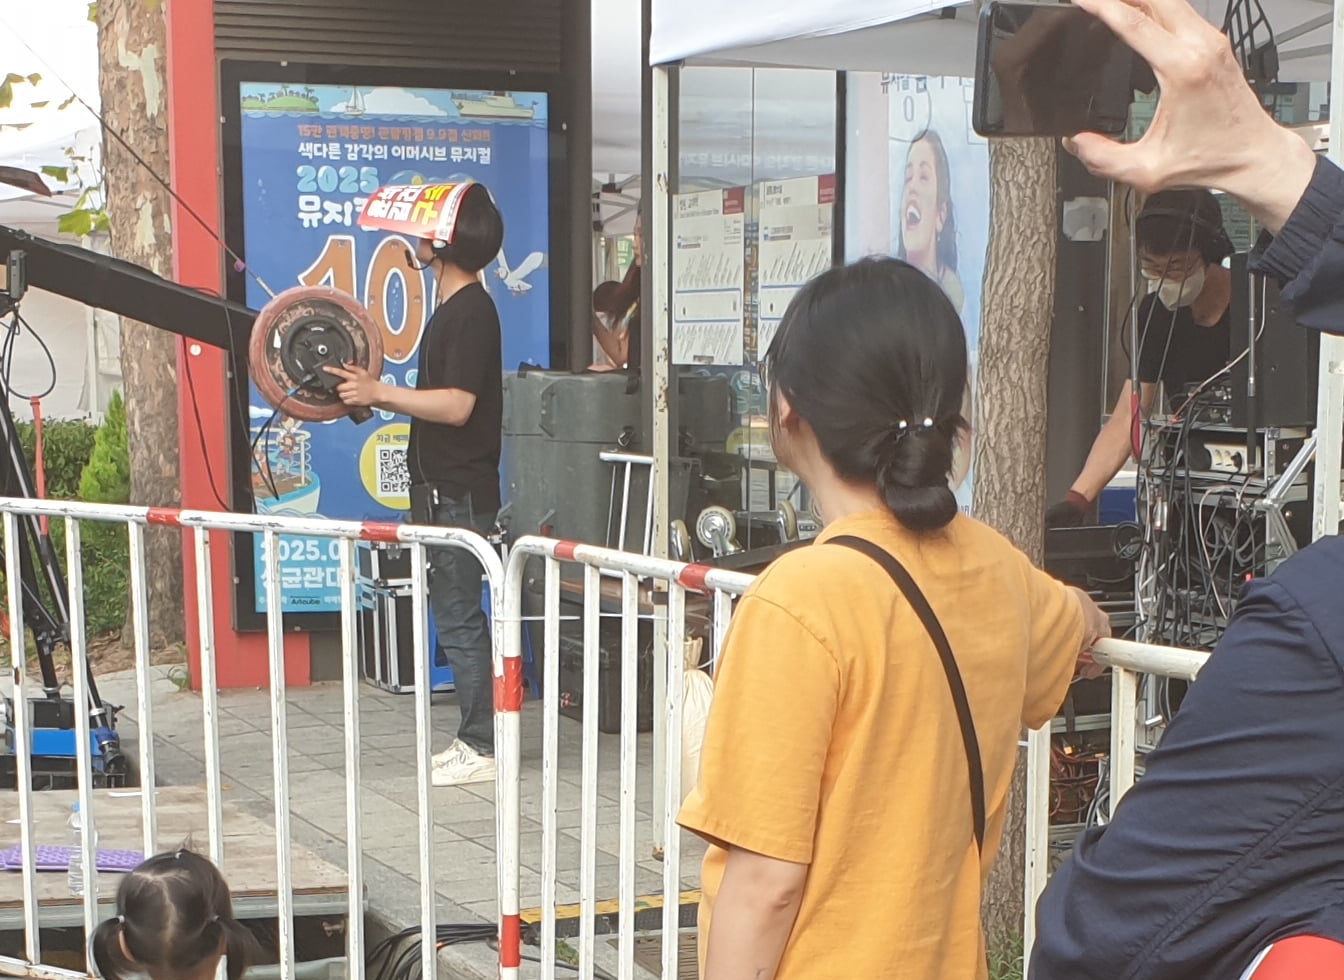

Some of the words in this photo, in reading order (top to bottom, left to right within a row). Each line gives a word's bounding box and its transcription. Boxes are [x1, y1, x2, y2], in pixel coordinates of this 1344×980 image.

[298, 142, 341, 160] 색다른
[344, 143, 388, 161] 감각의
[391, 145, 447, 161] 이머시브
[450, 147, 491, 165] 뮤지컬
[296, 164, 380, 194] 2025
